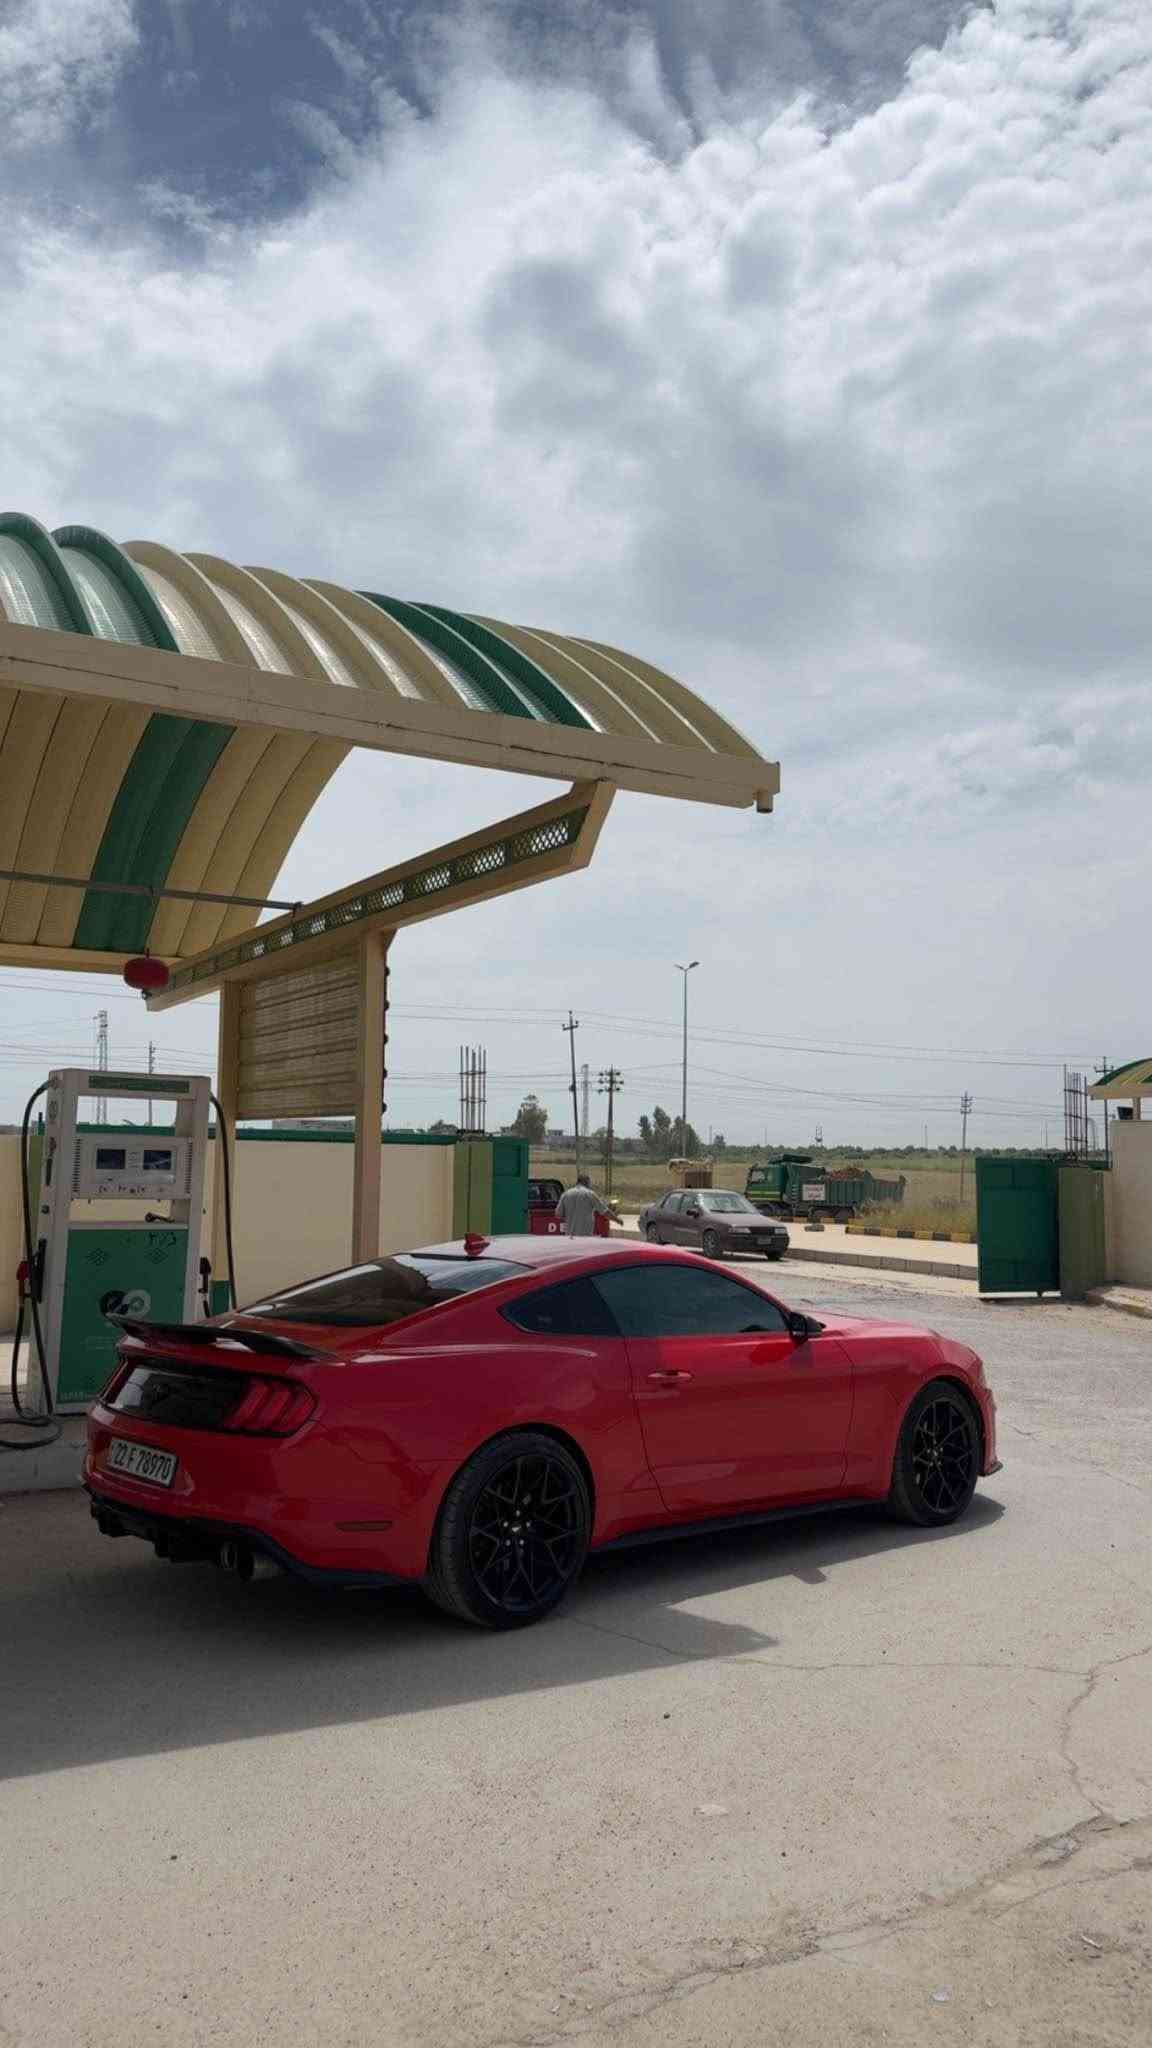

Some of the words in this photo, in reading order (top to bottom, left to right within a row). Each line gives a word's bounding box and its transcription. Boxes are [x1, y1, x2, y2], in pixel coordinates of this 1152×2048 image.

[114, 1442, 128, 1466] 22
[128, 1447, 137, 1468] F
[136, 1449, 172, 1480] 78970
